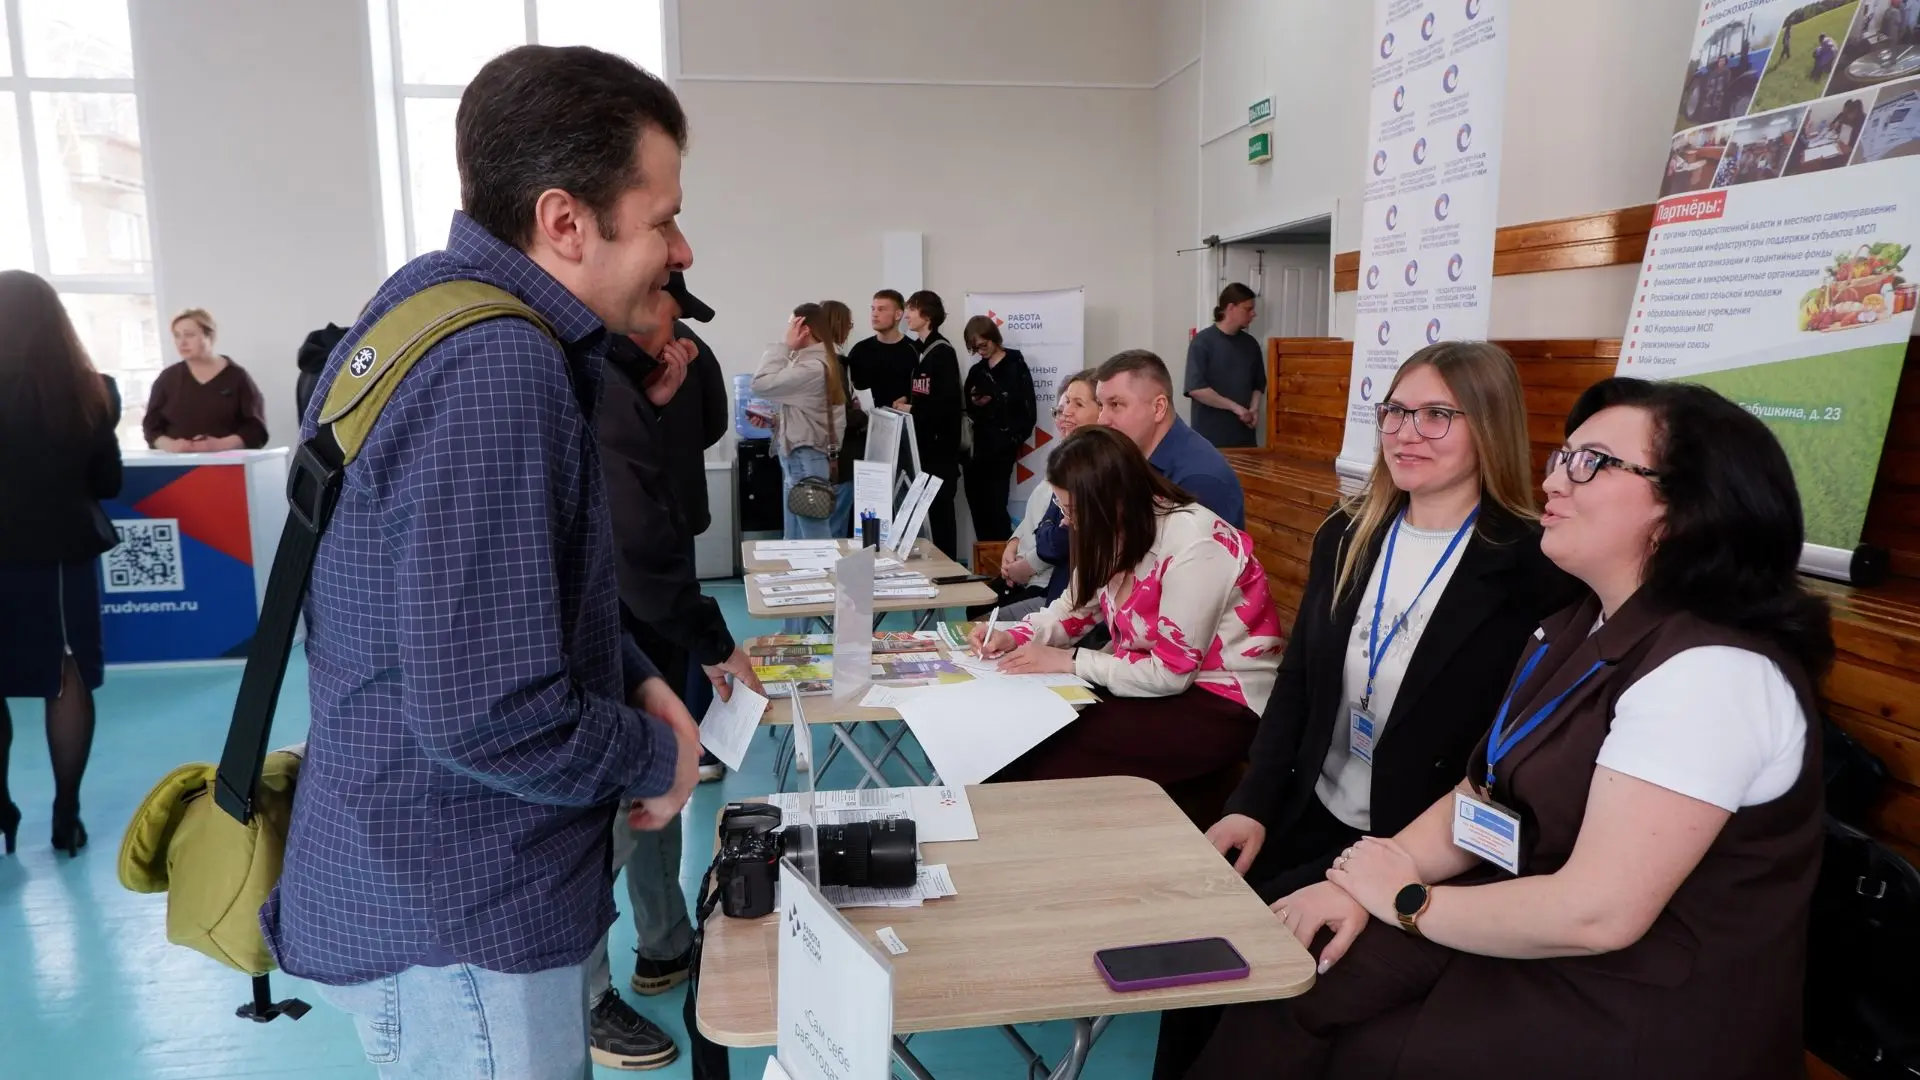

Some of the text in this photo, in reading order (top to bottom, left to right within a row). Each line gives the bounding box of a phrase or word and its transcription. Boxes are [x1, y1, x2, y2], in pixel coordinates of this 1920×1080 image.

[1656, 199, 1723, 221] Партнёры:
[1784, 214, 1822, 225] местного
[1855, 223, 1877, 235] МСП
[1804, 249, 1833, 260] фонды
[1643, 324, 1653, 332] АО
[1697, 323, 1714, 332] МСП
[1638, 355, 1652, 364] Мой
[1029, 366, 1058, 374] нные
[1036, 393, 1056, 401] еле
[1738, 402, 1842, 421] абушкина, д. 23
[827, 1037, 850, 1073] себе
